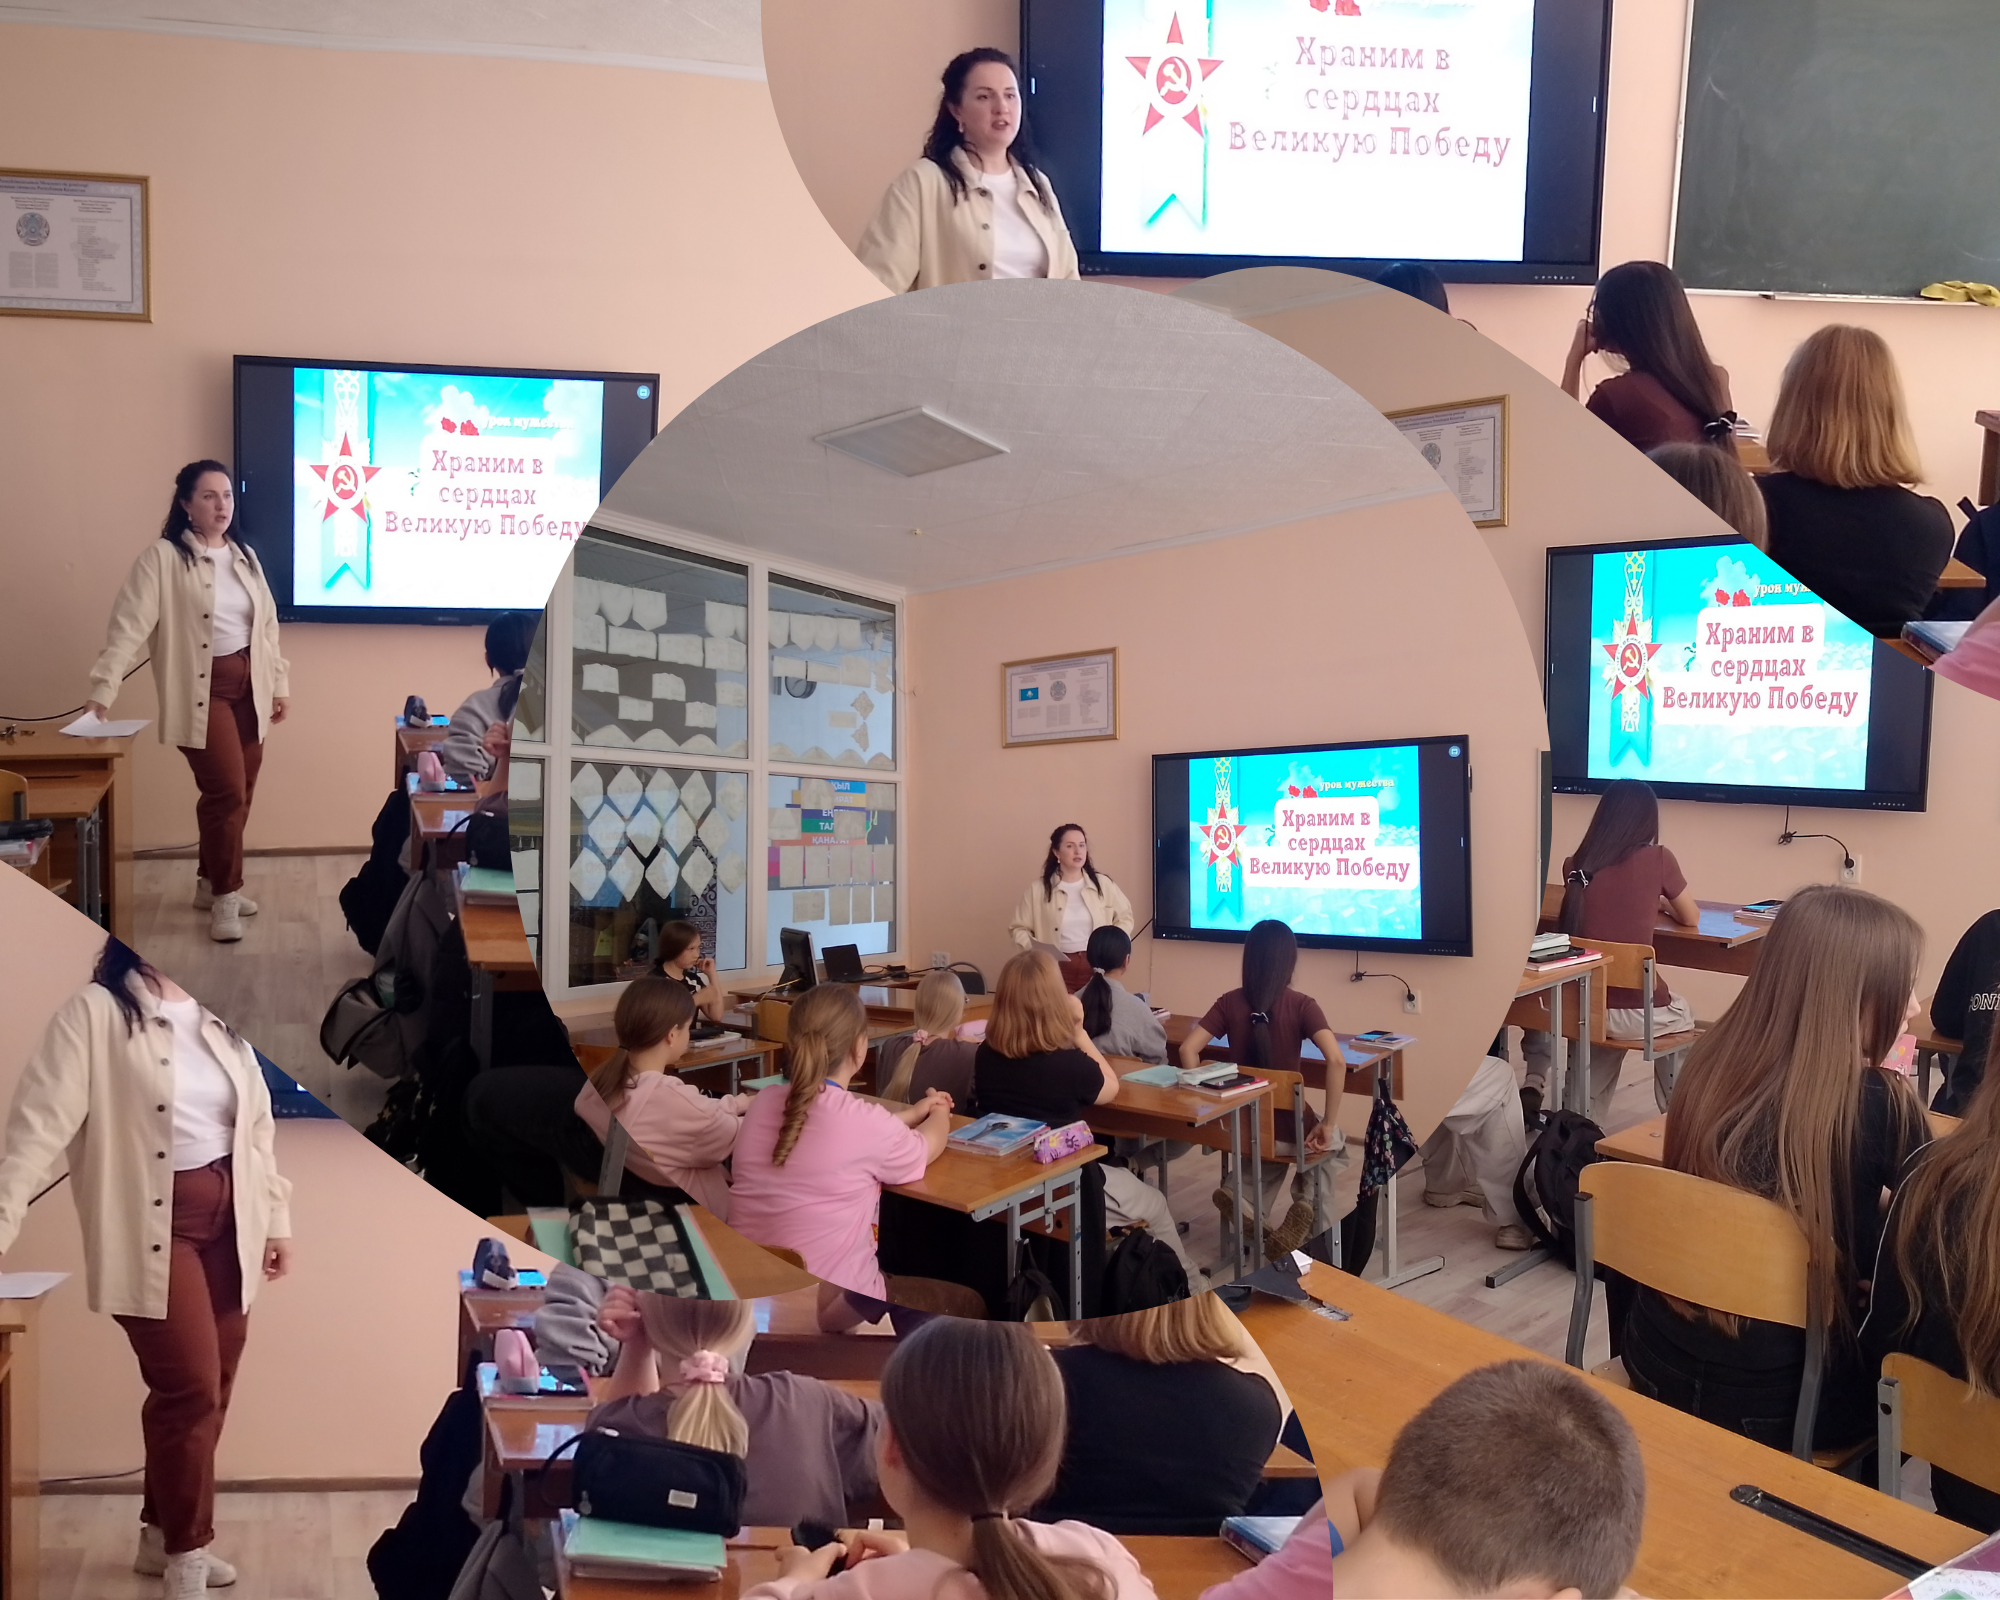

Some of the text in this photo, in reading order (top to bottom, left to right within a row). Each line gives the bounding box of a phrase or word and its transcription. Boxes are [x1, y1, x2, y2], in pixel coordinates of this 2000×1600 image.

[1295, 36, 1450, 76] Храним в
[1304, 88, 1440, 120] сердцах
[1229, 122, 1511, 167] Великую Победу
[432, 450, 543, 478] Храним в
[439, 486, 536, 510] сердцах
[385, 511, 491, 540] Великую
[1753, 583, 1782, 598] урок
[1706, 623, 1814, 652] Храним в
[1711, 659, 1806, 684] сердцах
[1663, 684, 1858, 717] Великую Победу
[831, 781, 850, 790] ҚЫЛ
[1319, 779, 1395, 791] урок мужества
[1282, 810, 1371, 832] Храним в
[1288, 837, 1366, 857] сердцах
[1250, 856, 1411, 882] Великую Победу
